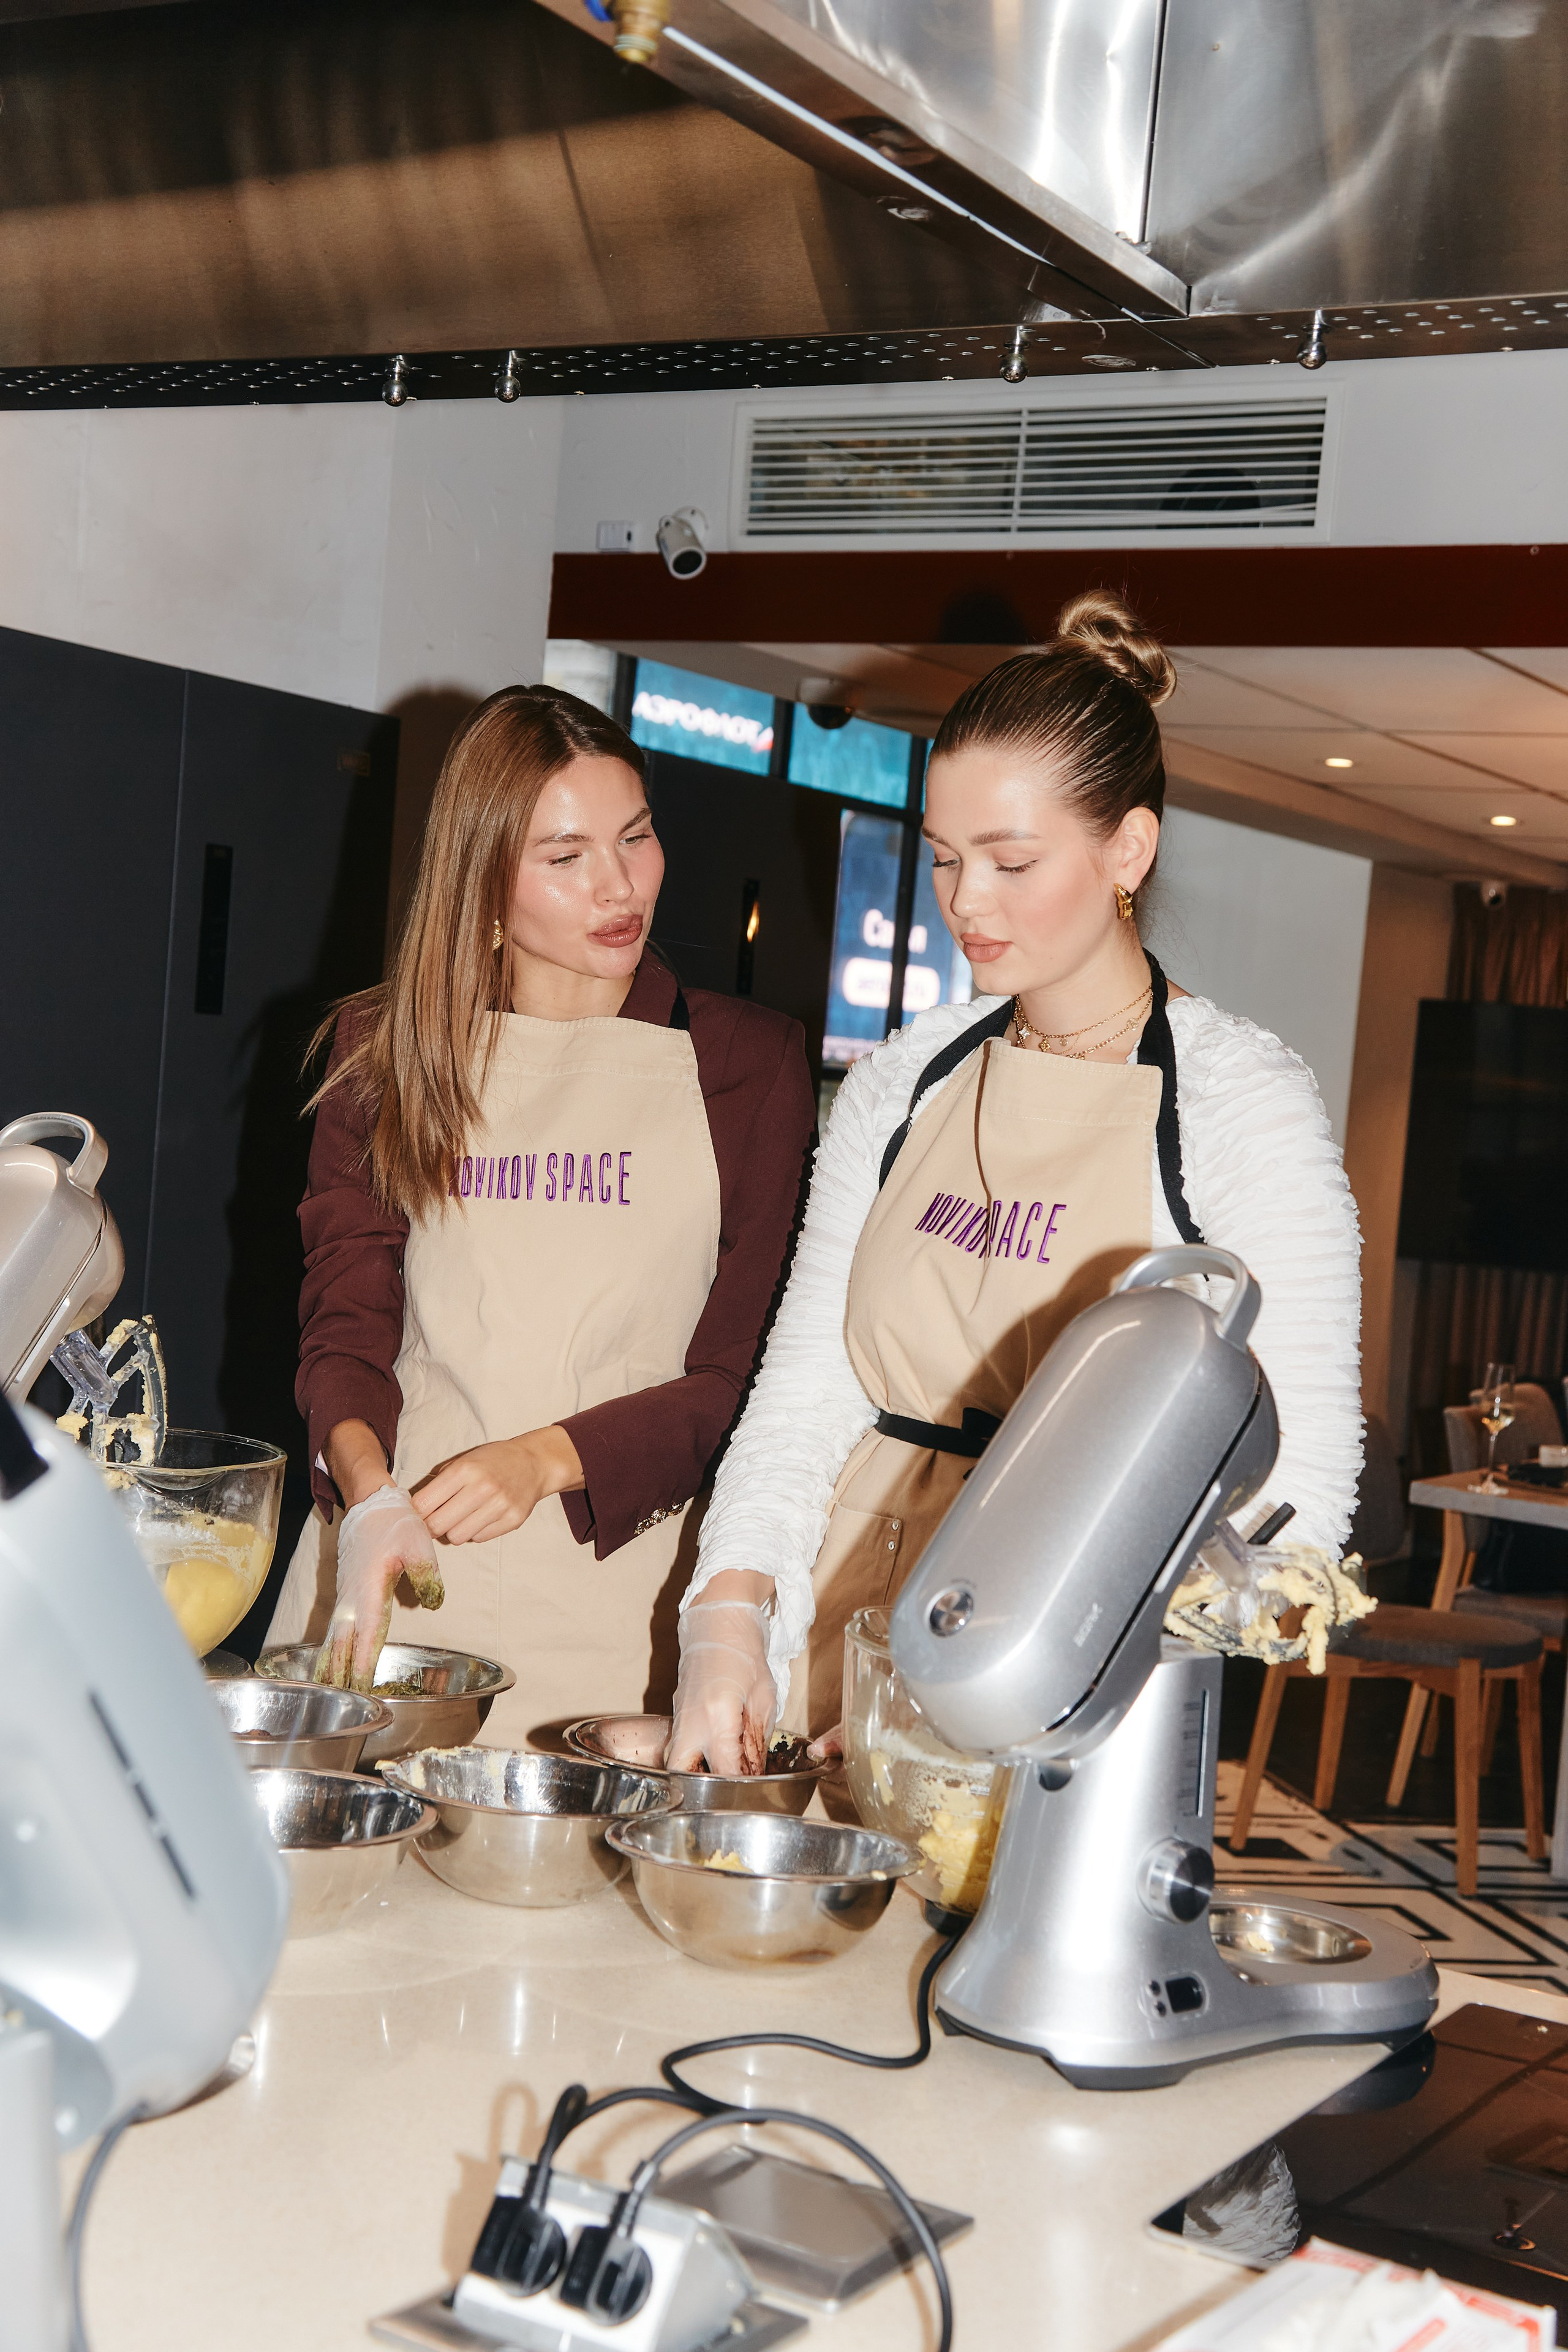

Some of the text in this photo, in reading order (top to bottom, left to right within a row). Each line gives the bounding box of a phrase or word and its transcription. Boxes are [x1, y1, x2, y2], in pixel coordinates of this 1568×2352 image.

[545, 1151, 632, 1205] SPACE
[914, 1192, 1067, 1264] NOVIKO PACE
